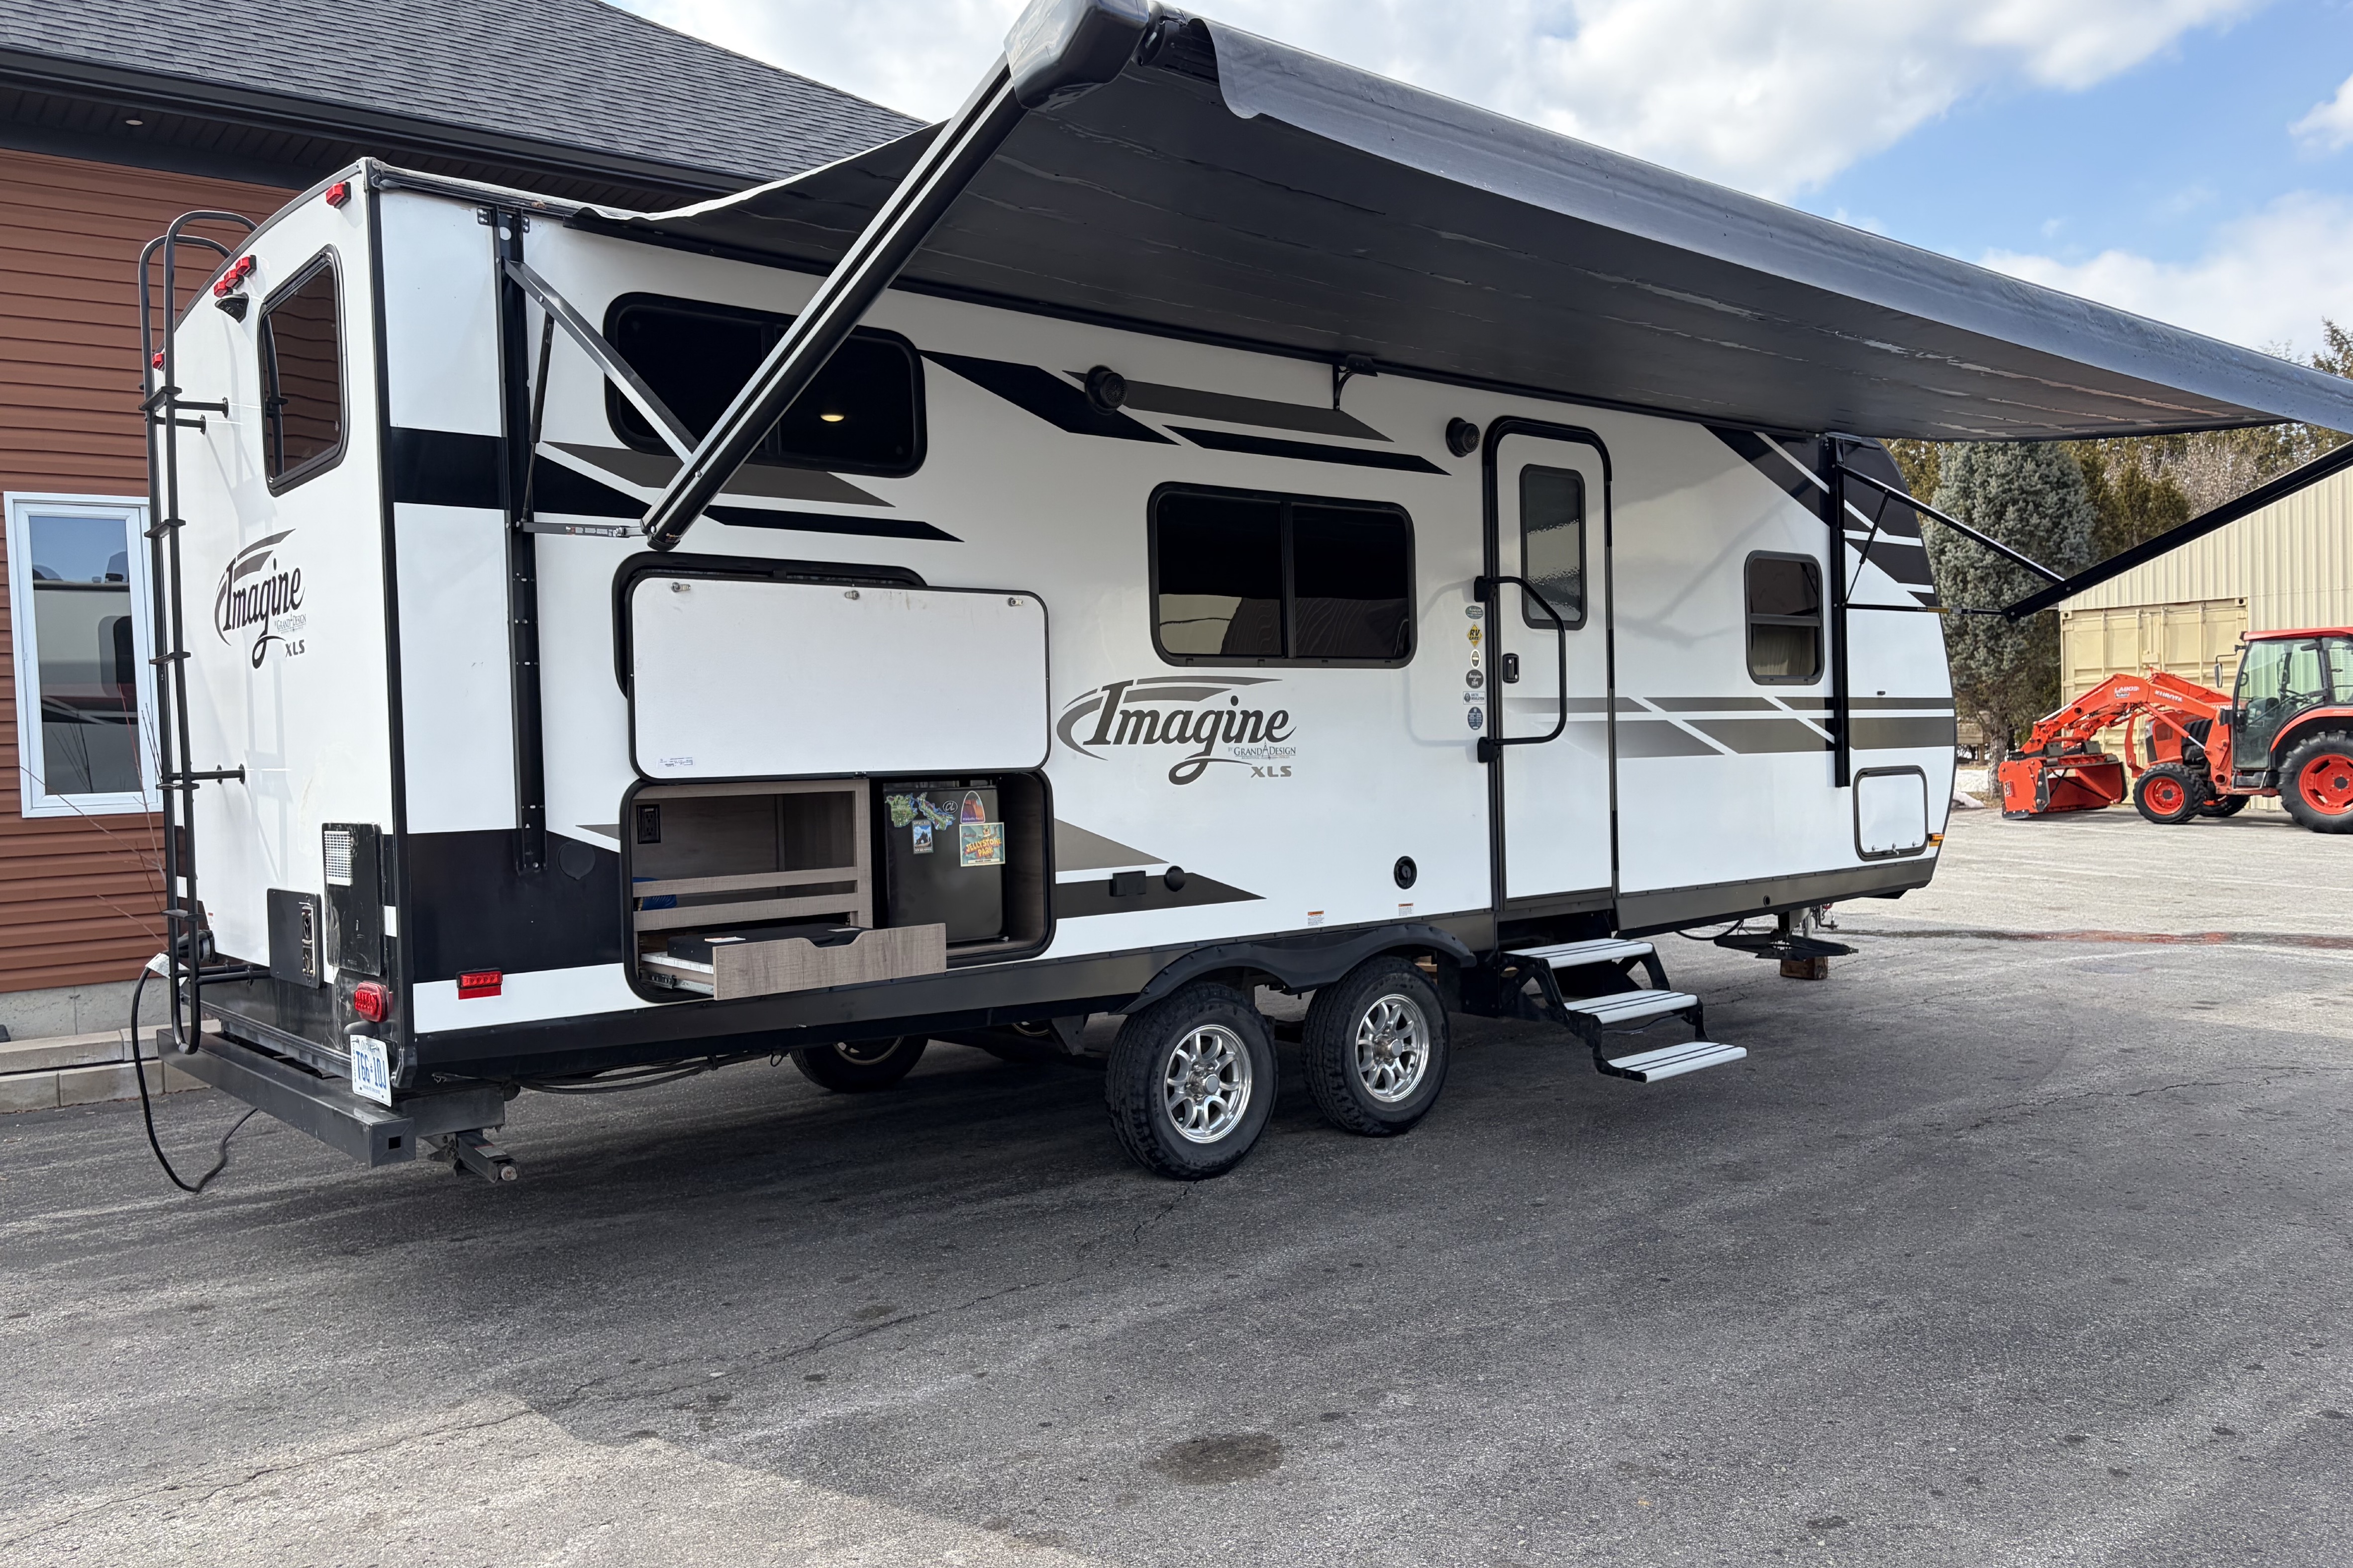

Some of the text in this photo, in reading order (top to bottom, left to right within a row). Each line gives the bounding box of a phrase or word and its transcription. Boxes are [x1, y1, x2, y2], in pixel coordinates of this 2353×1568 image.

[222, 557, 306, 669] Imagine
[285, 639, 305, 658] XLS
[2154, 689, 2183, 702] KUBOTA
[1083, 679, 1297, 785] Imagine
[1234, 747, 1262, 756] GRAND
[1269, 746, 1296, 755] DESIGN
[1251, 766, 1292, 778] XLS
[966, 837, 1002, 853] JELLYSTONE
[978, 846, 993, 857] PARK
[356, 1050, 370, 1083] T66
